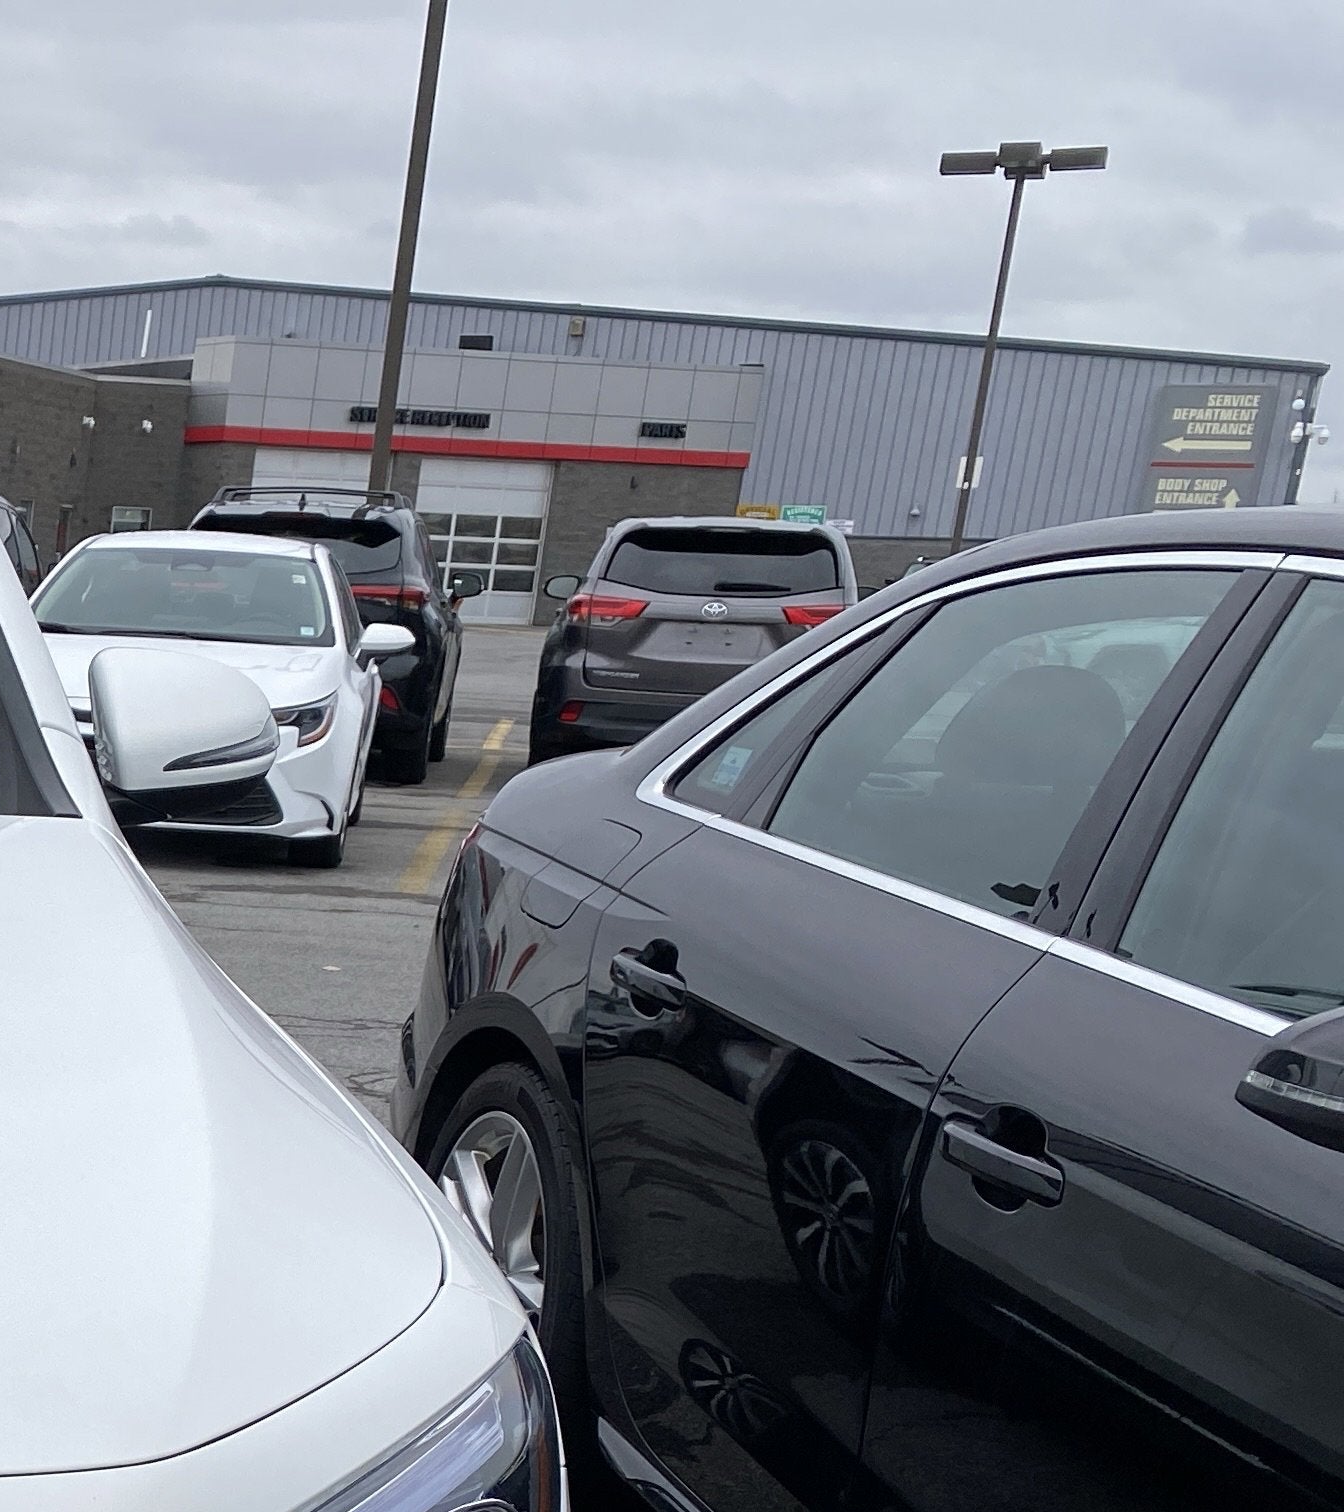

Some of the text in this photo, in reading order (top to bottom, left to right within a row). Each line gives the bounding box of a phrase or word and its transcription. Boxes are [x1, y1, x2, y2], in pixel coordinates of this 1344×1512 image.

[1207, 394, 1261, 407] SERVICE
[1172, 408, 1259, 421] DEPARTMENT
[1186, 422, 1255, 435] ENTRANCE
[1157, 478, 1228, 491] BODY SHOP
[1154, 491, 1220, 505] ENTRANCE
